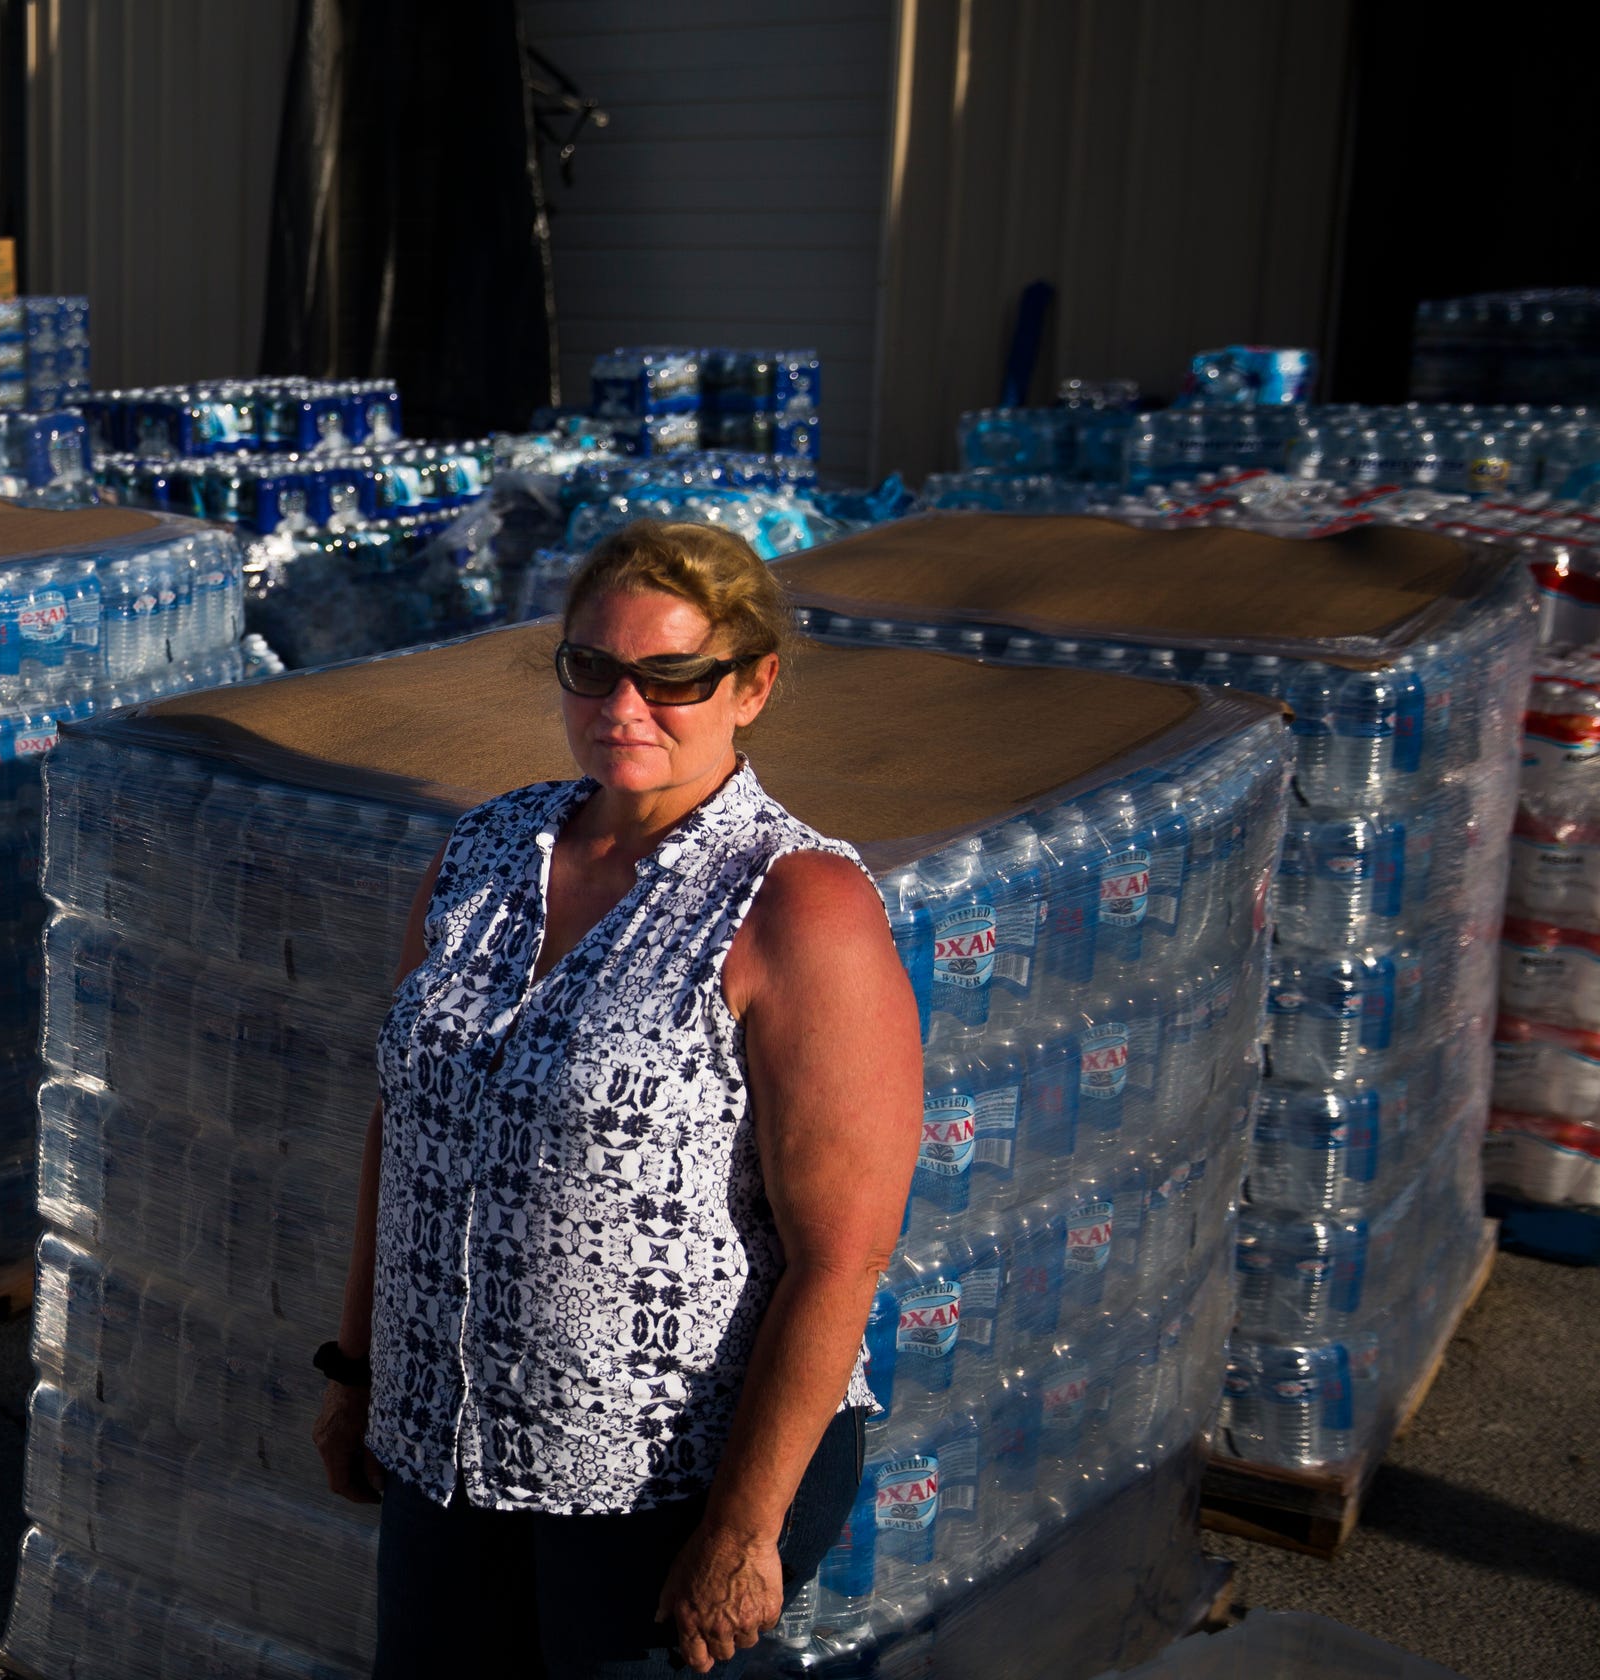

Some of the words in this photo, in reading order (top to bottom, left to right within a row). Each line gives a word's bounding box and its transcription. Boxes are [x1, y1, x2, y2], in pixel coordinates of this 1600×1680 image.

[934, 928, 997, 959] OXAN
[942, 973, 981, 987] WATER
[924, 1097, 968, 1110] RIFIED
[921, 1157, 959, 1174] WATER
[900, 1301, 960, 1328] OXAN
[905, 1343, 943, 1355] WATER
[877, 1473, 938, 1506] OXAN
[885, 1519, 924, 1531] WATER
